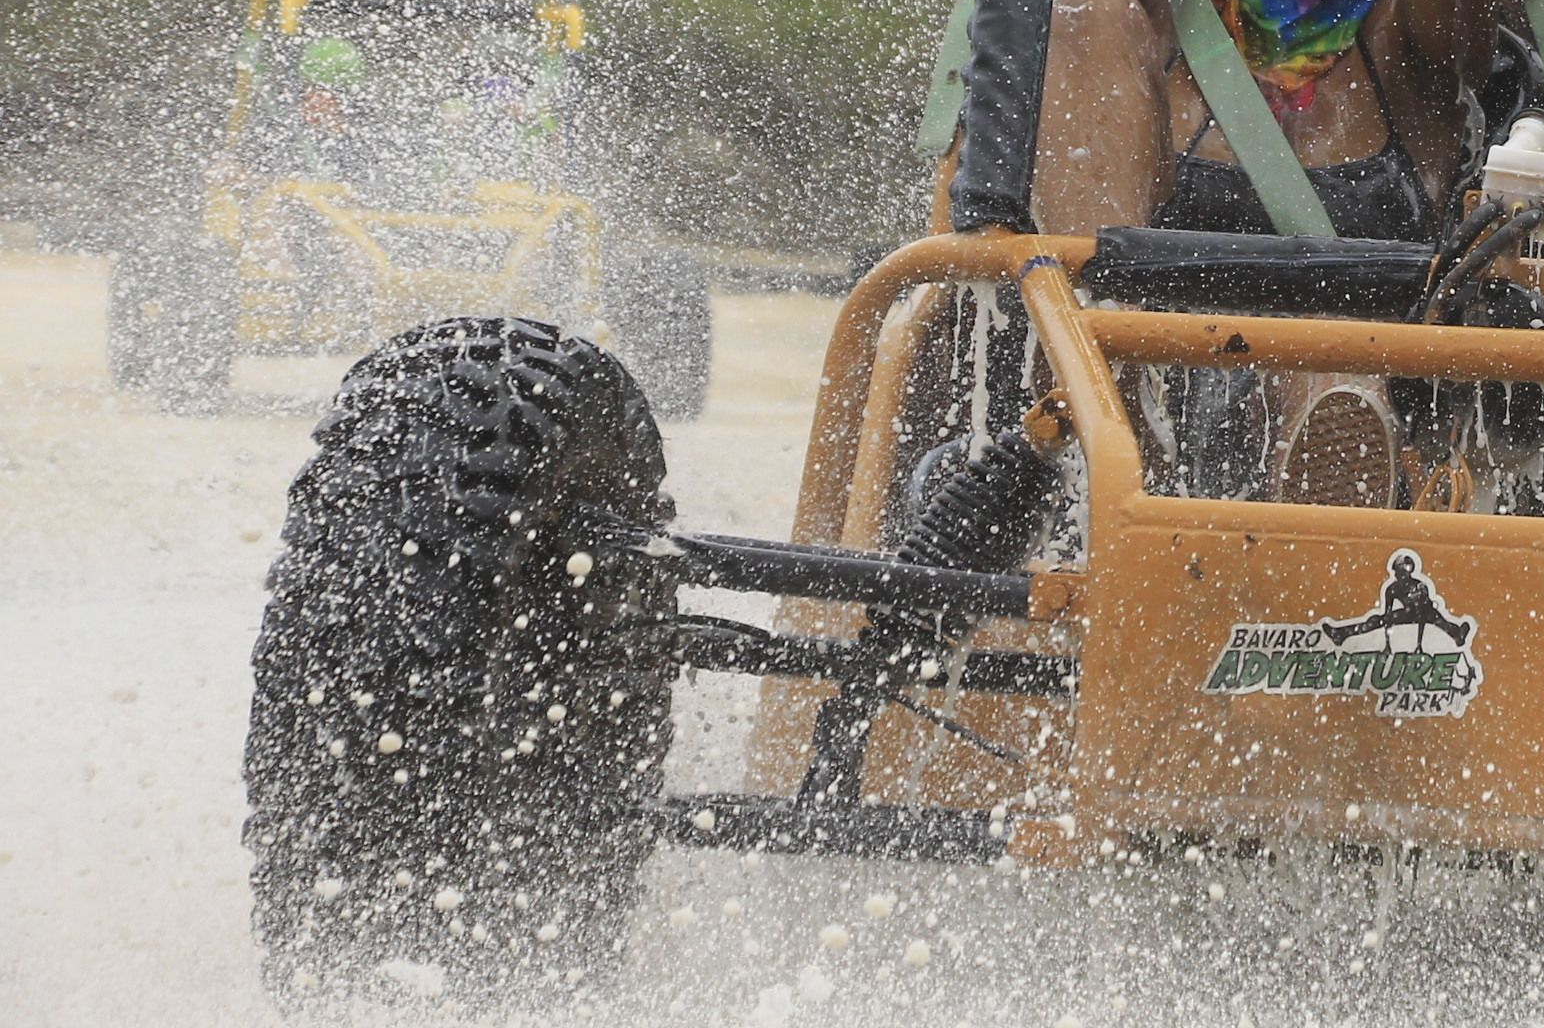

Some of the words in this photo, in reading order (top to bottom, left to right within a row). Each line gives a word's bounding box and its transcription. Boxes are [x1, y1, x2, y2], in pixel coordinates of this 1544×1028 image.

[1230, 628, 1322, 649] BAVARO
[1207, 650, 1460, 691] ADVENTURE
[1380, 692, 1448, 713] PARK
